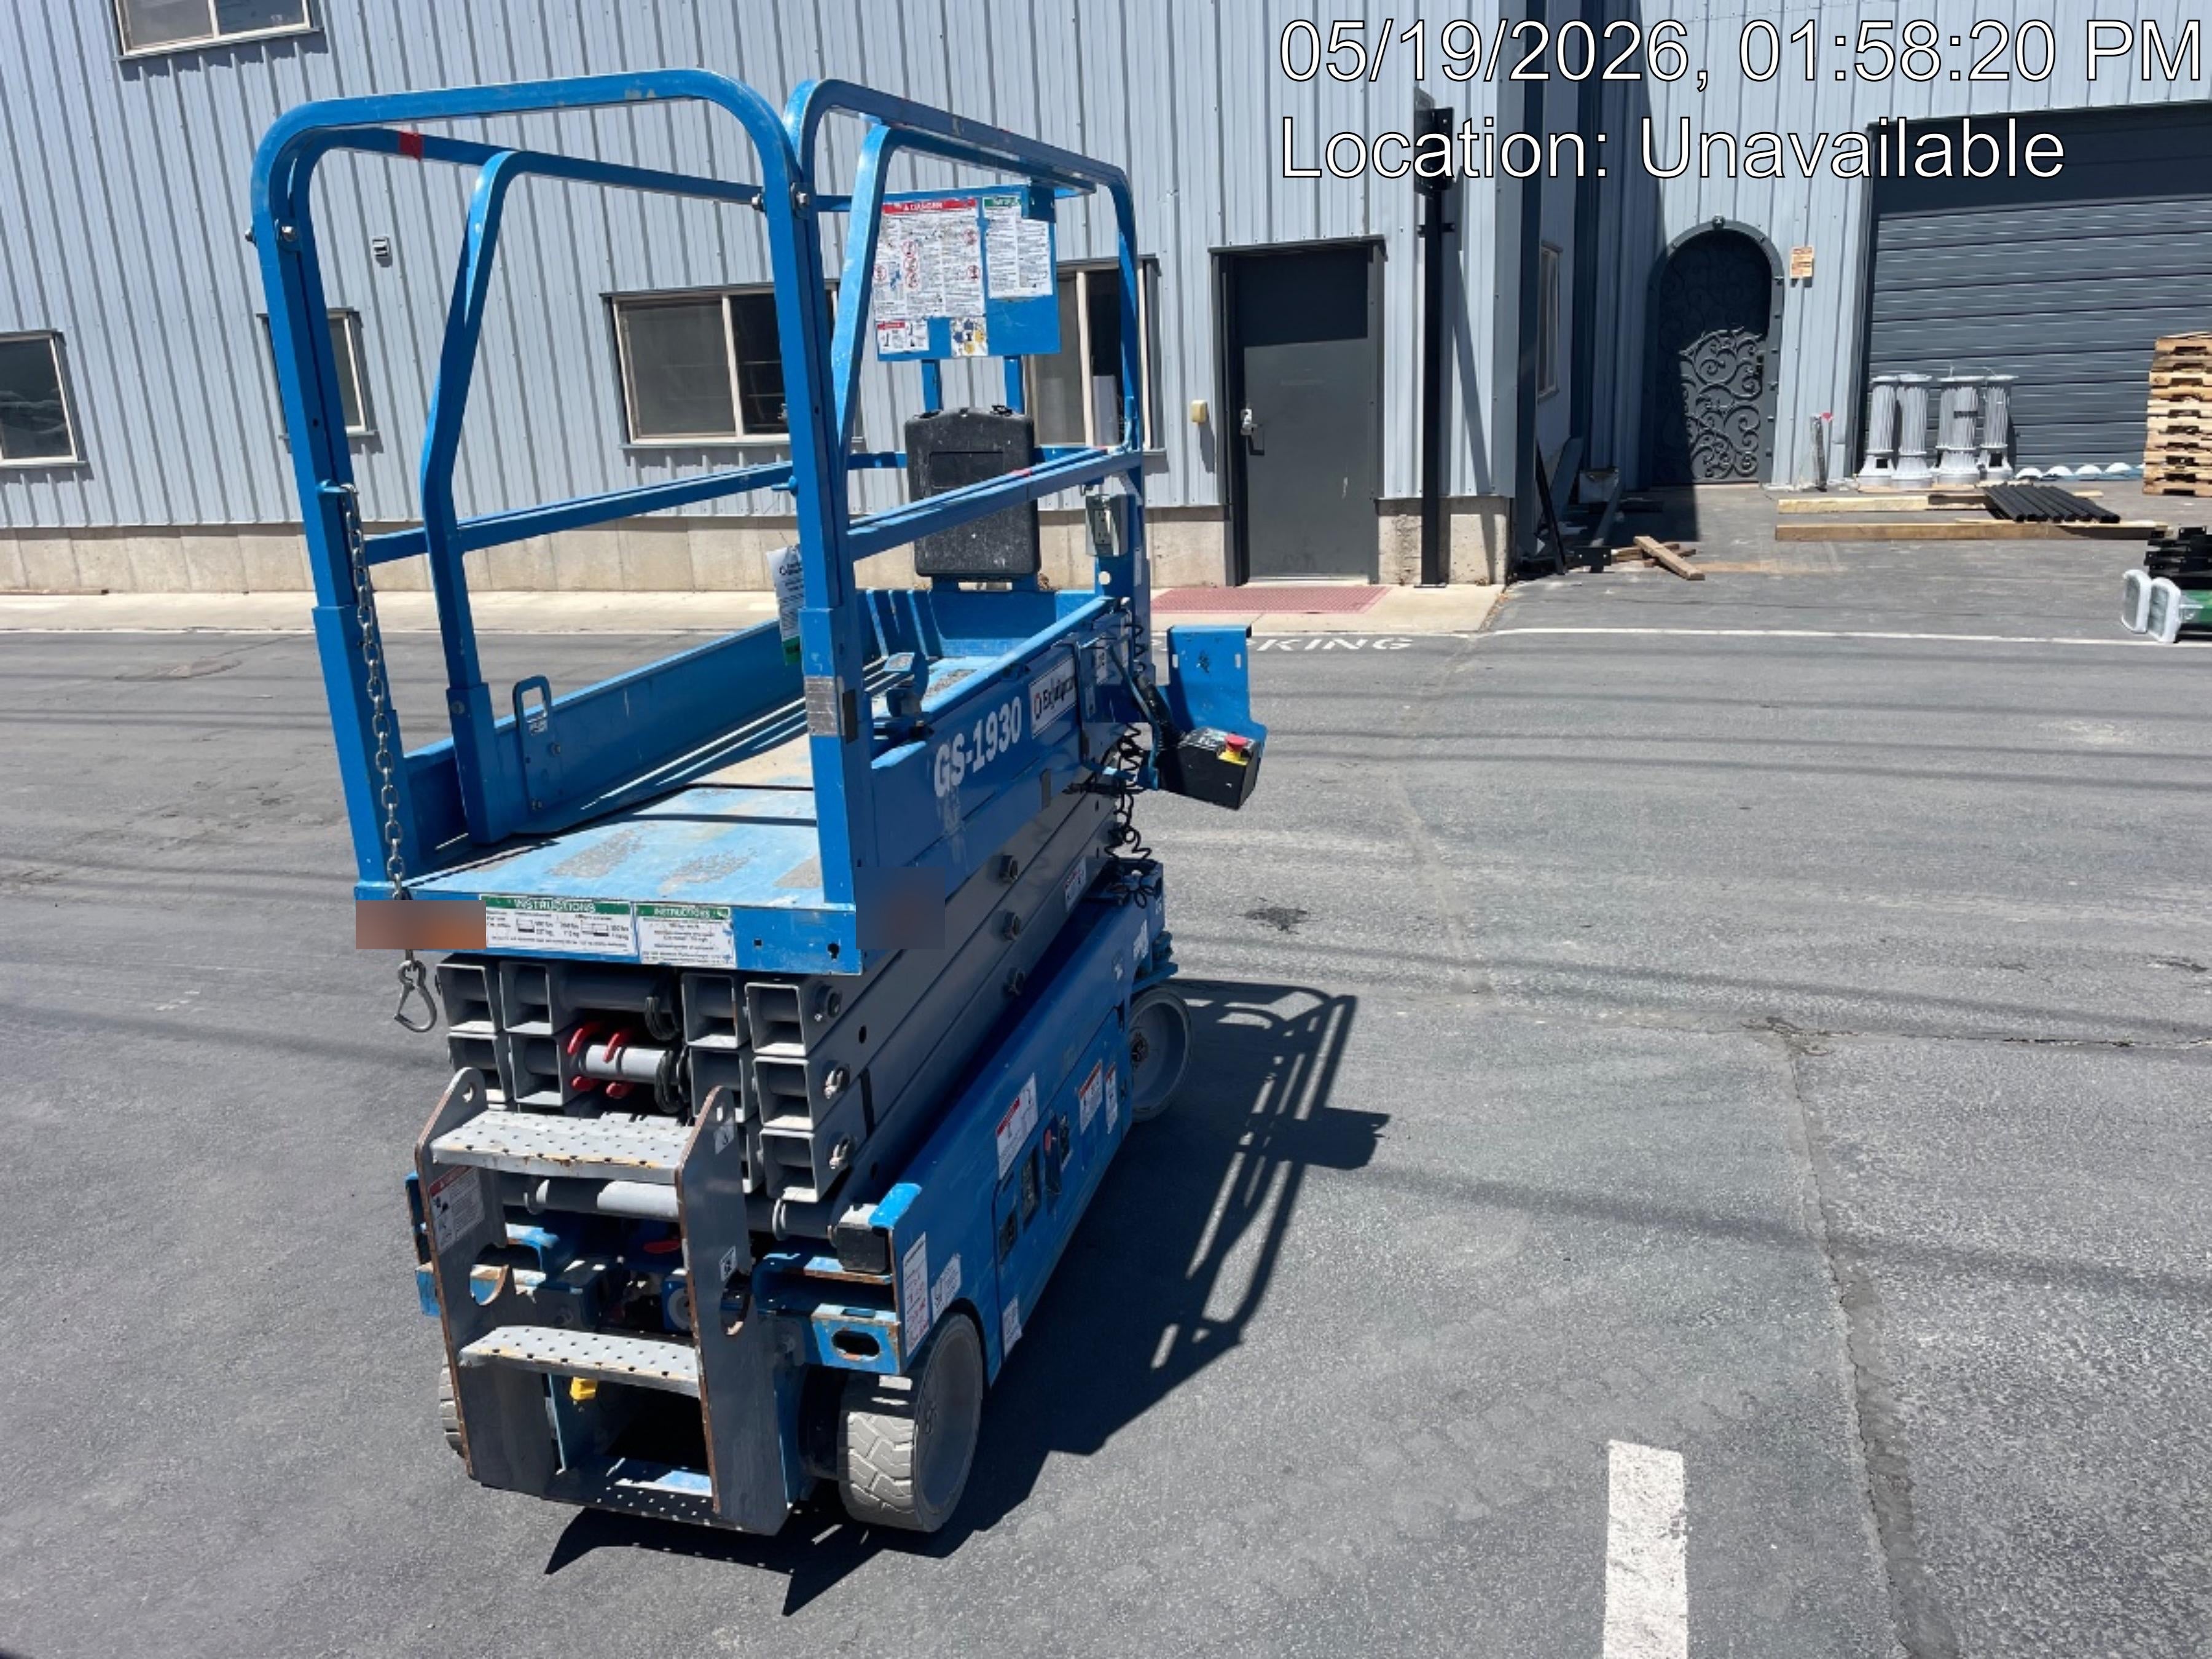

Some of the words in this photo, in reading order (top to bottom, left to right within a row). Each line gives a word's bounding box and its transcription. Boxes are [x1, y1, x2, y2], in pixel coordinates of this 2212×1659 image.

[1151, 637, 1413, 651] KING
[934, 696, 1022, 798] GS-1930
[514, 898, 595, 912] INSTRUCTIONS
